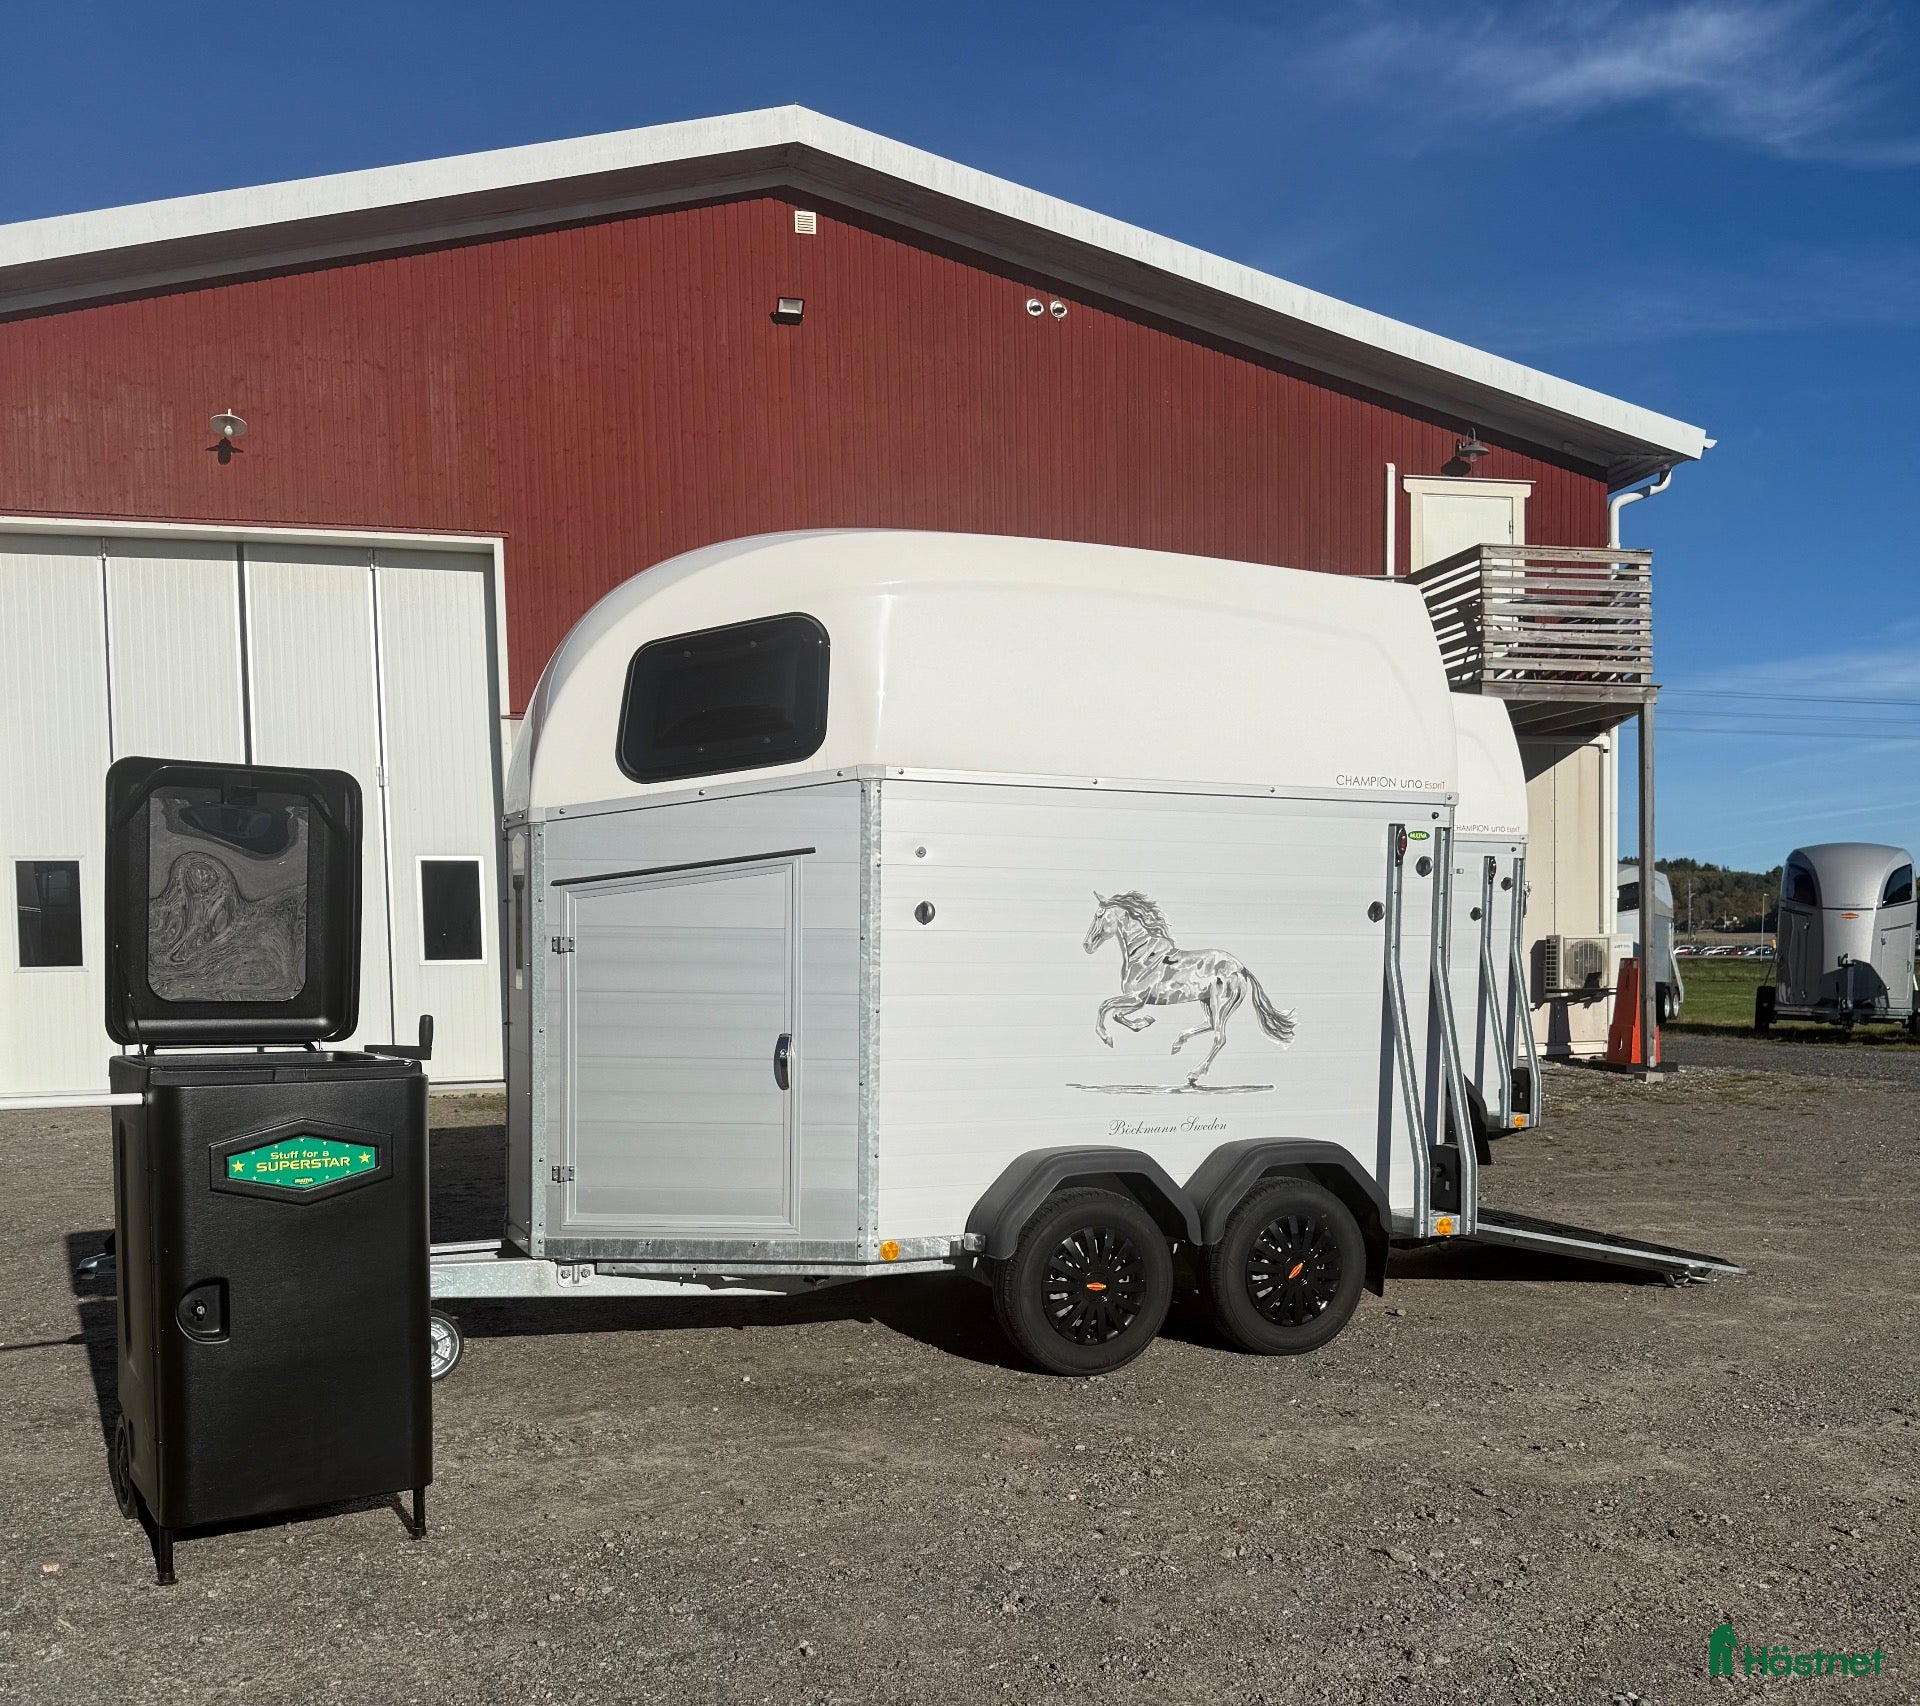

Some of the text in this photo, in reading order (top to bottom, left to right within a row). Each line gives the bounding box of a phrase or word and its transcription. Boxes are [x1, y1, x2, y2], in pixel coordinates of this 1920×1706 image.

[1336, 774, 1396, 788] CHAMPION
[1108, 1115, 1227, 1136] Böckmann Sweden
[270, 1150, 299, 1160] Stuff
[302, 1150, 319, 1158] for
[256, 1156, 351, 1173] SUPERSTAR
